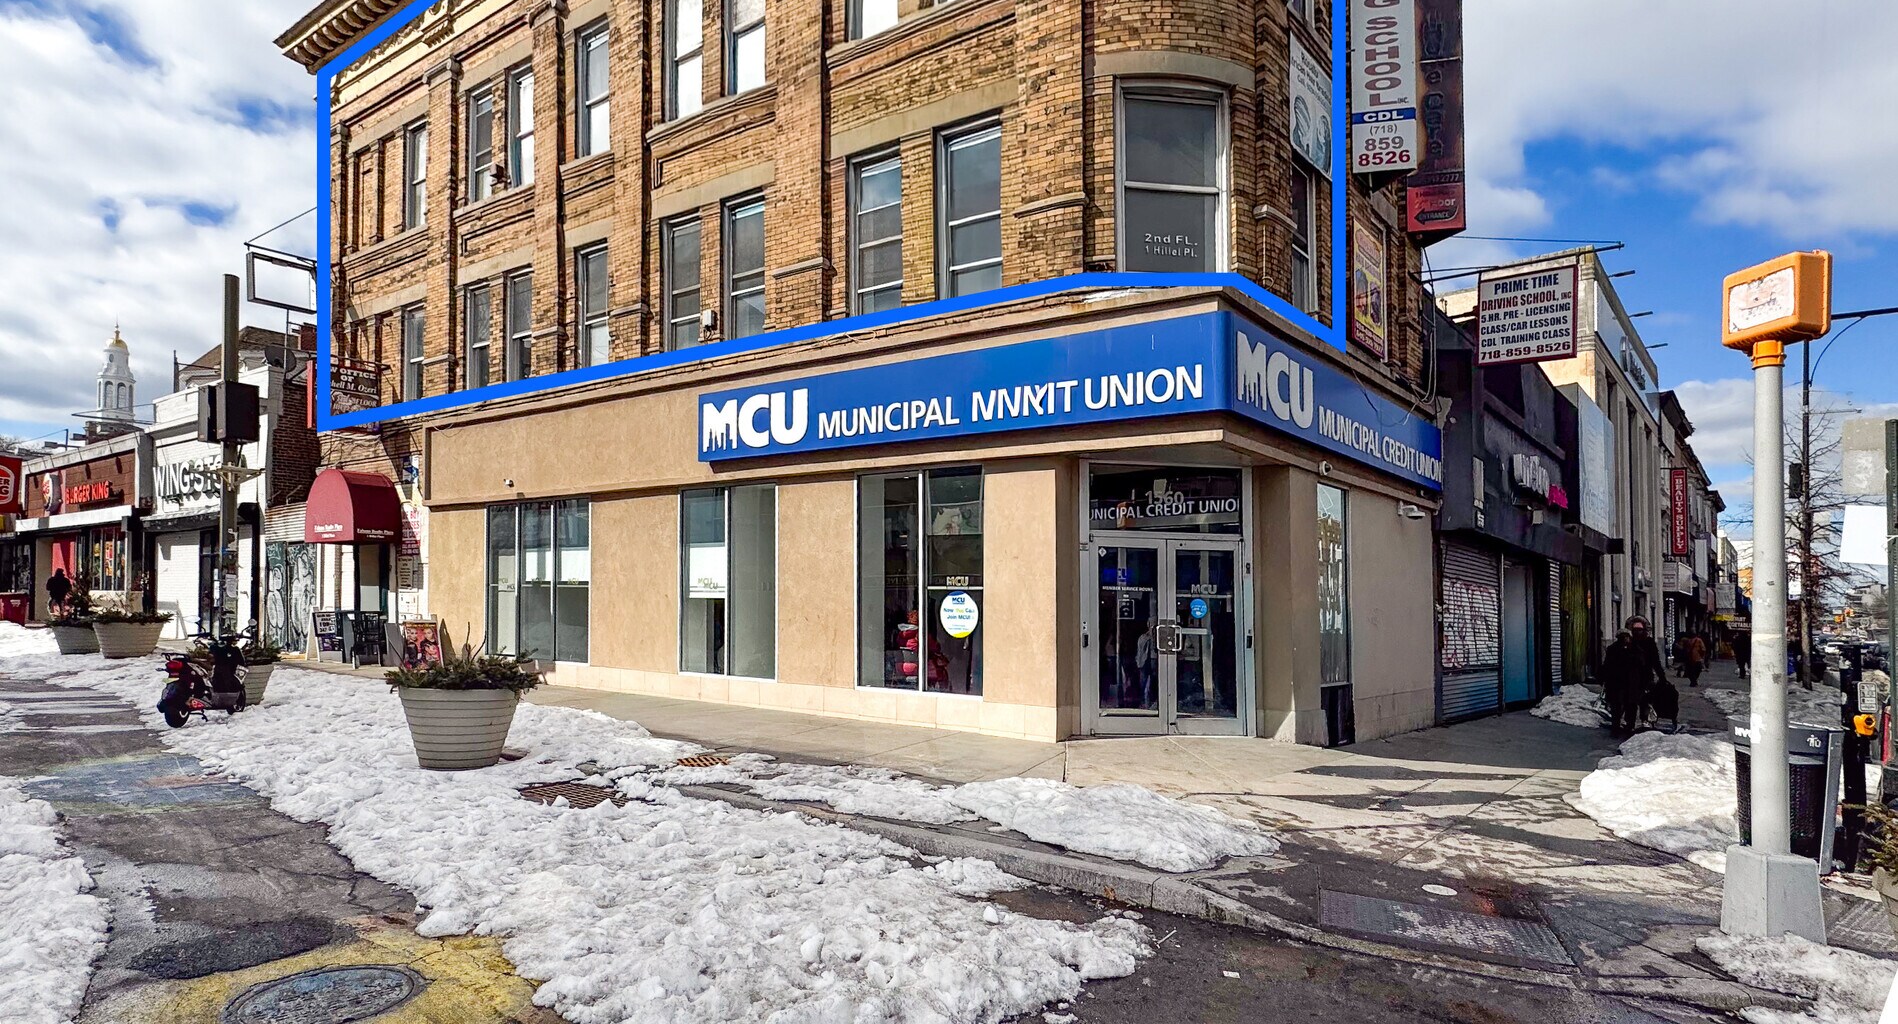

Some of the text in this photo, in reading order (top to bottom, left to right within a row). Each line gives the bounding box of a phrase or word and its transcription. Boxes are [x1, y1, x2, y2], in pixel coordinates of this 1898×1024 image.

[1364, 16, 1402, 107] SCHOOL
[1363, 110, 1405, 122] CDL
[1369, 123, 1398, 136] (718)
[1364, 135, 1404, 152] 859
[1358, 149, 1411, 167] 8526
[1145, 233, 1198, 246] 2nd FL.
[1145, 245, 1150, 253] 1
[1153, 246, 1181, 256] Hillel
[1494, 273, 1559, 295] PRIME TIME
[1481, 295, 1518, 312] DRIVING
[1520, 290, 1559, 306] SCHOOL,
[1503, 309, 1518, 320] PRE
[1525, 302, 1571, 316] LICENSING
[1481, 315, 1568, 335] CLASS/CAR LESSONS
[1481, 327, 1570, 348] CDL TRAINING CLASS
[1480, 341, 1571, 361] 718-859-8526
[1237, 330, 1314, 429] MCU
[818, 396, 960, 440] MUNICIPAL
[1084, 364, 1203, 410] UNION
[702, 387, 809, 453] MCU
[1318, 405, 1442, 483] MUNICIPAL CREDIT UNION
[91, 480, 110, 501] KING
[1144, 490, 1185, 505] 1560
[1145, 500, 1195, 517] CREDIT
[1674, 478, 1685, 549] BEAUTY SUPPLY
[946, 576, 969, 586] MCU
[1190, 584, 1218, 595] MCU
[1734, 726, 1751, 739] NY
